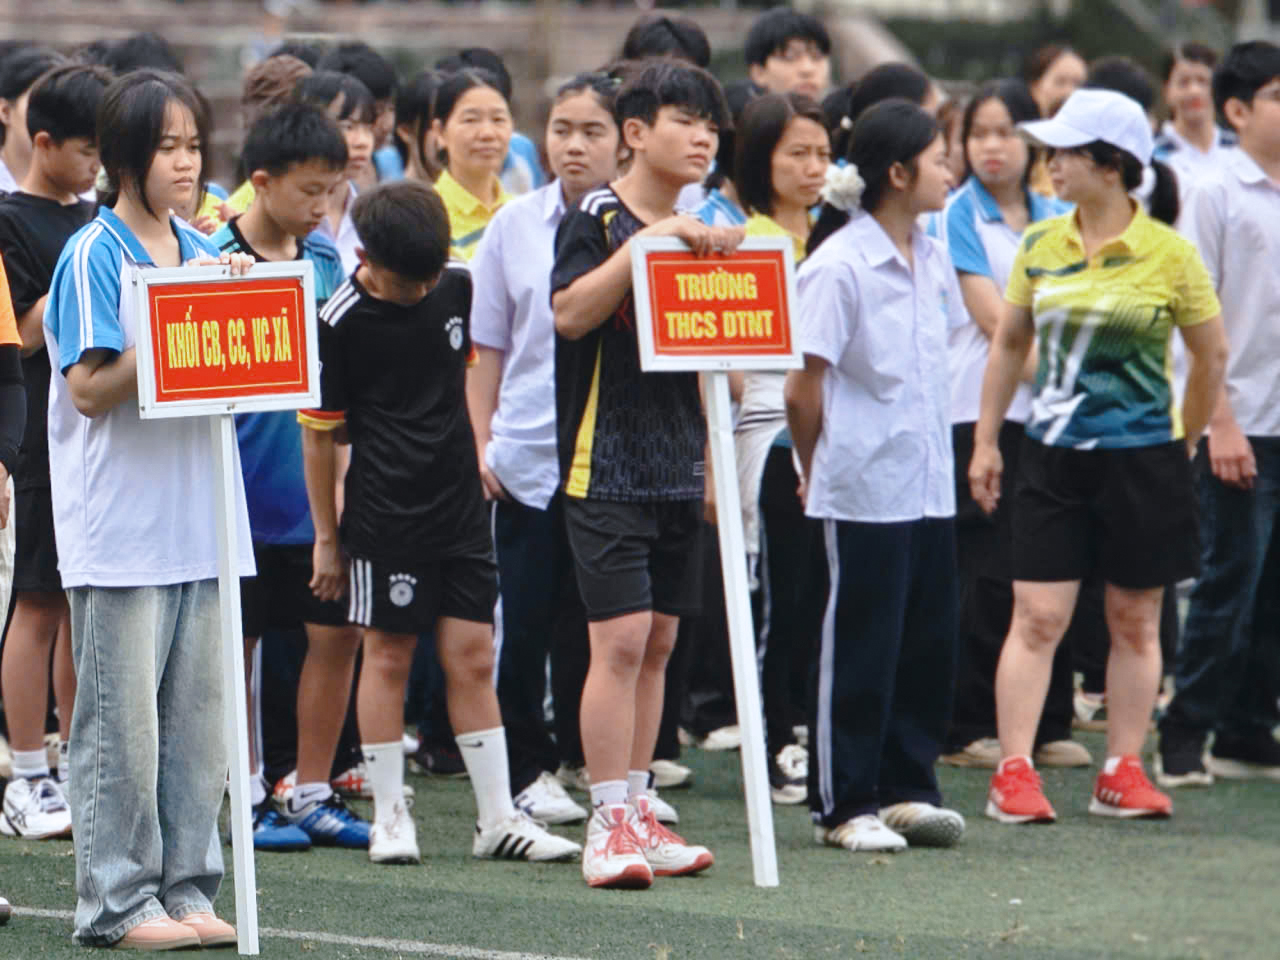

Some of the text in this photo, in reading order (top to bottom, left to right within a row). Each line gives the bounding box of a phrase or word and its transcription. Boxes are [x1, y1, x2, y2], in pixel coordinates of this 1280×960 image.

[675, 266, 758, 301] TRƯỜNG
[166, 305, 292, 371] KHỐI CB, CC, VC XÃ
[665, 311, 718, 339] THCS
[722, 310, 774, 338] DTNT
